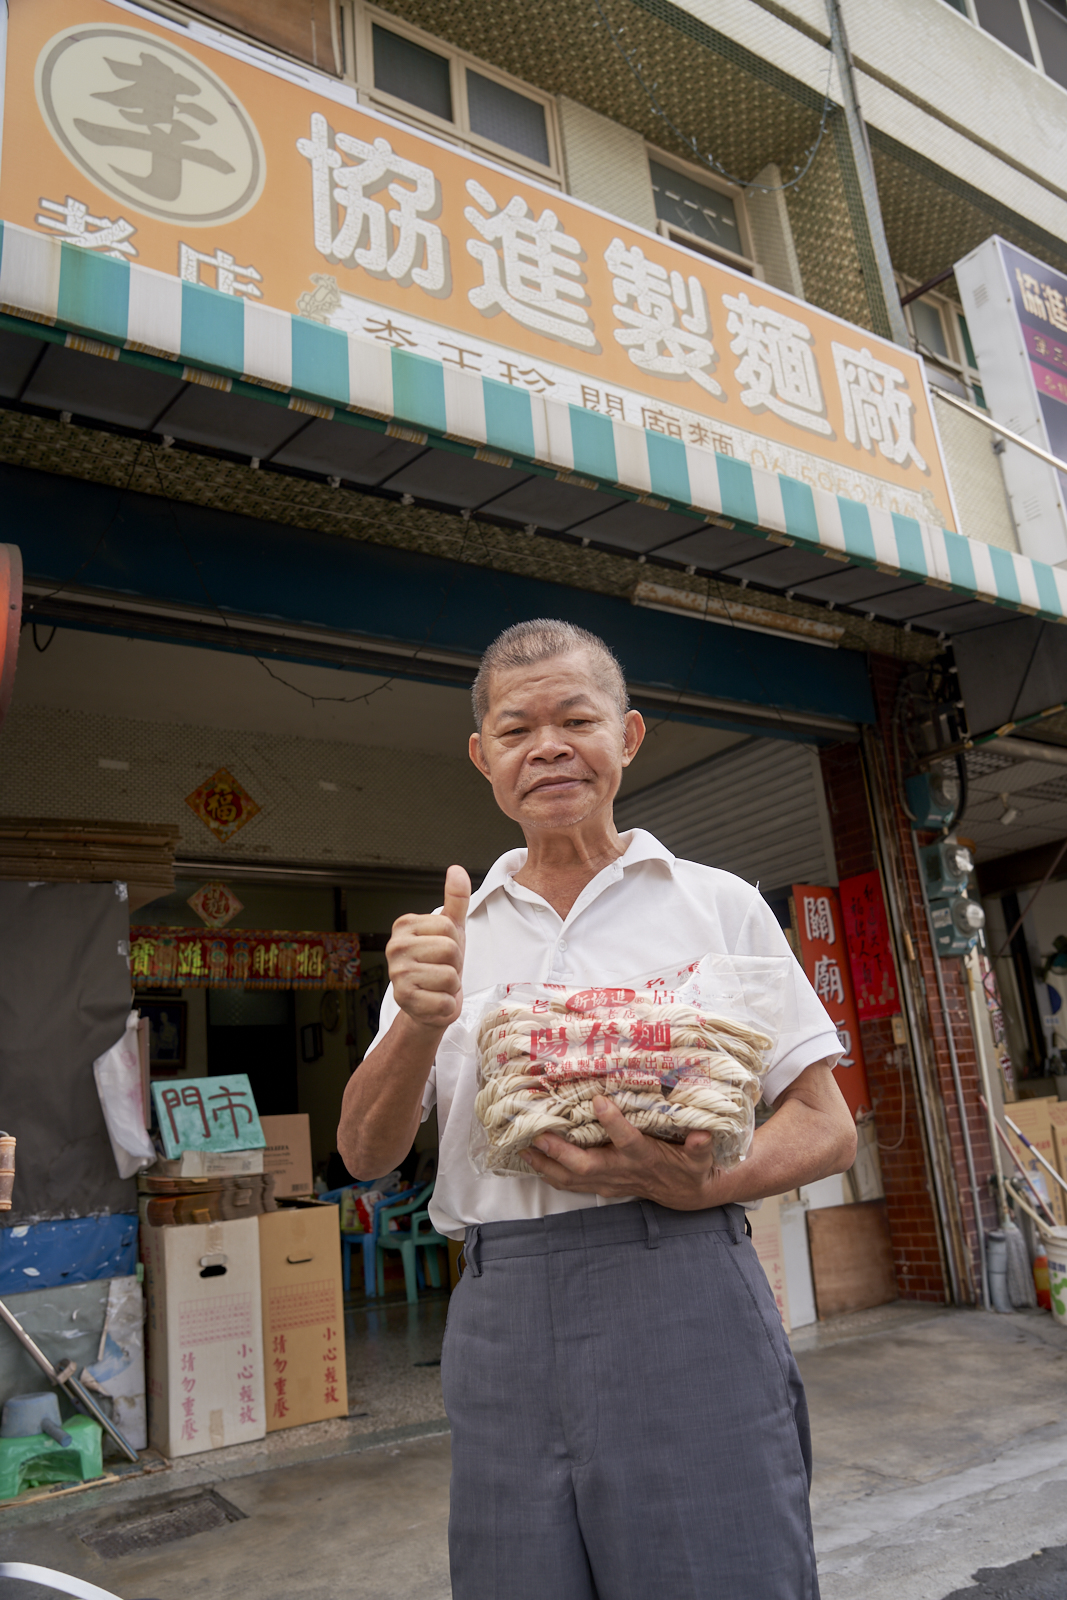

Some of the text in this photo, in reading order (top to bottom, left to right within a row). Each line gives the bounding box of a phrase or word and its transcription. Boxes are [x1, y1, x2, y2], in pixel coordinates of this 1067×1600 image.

[73, 52, 236, 203] 李
[296, 111, 930, 475] 協進製麵廠
[1015, 267, 1067, 333] 協進
[206, 793, 237, 822] 福
[570, 988, 630, 1011] 新協進
[530, 1019, 671, 1061] 陽春麵
[162, 1085, 254, 1144] 門市
[180, 1352, 199, 1441] 請勿重壓
[236, 1343, 258, 1424] 小心輕放
[272, 1334, 290, 1419] 請勿重壓
[322, 1327, 339, 1404] 小心輕放
